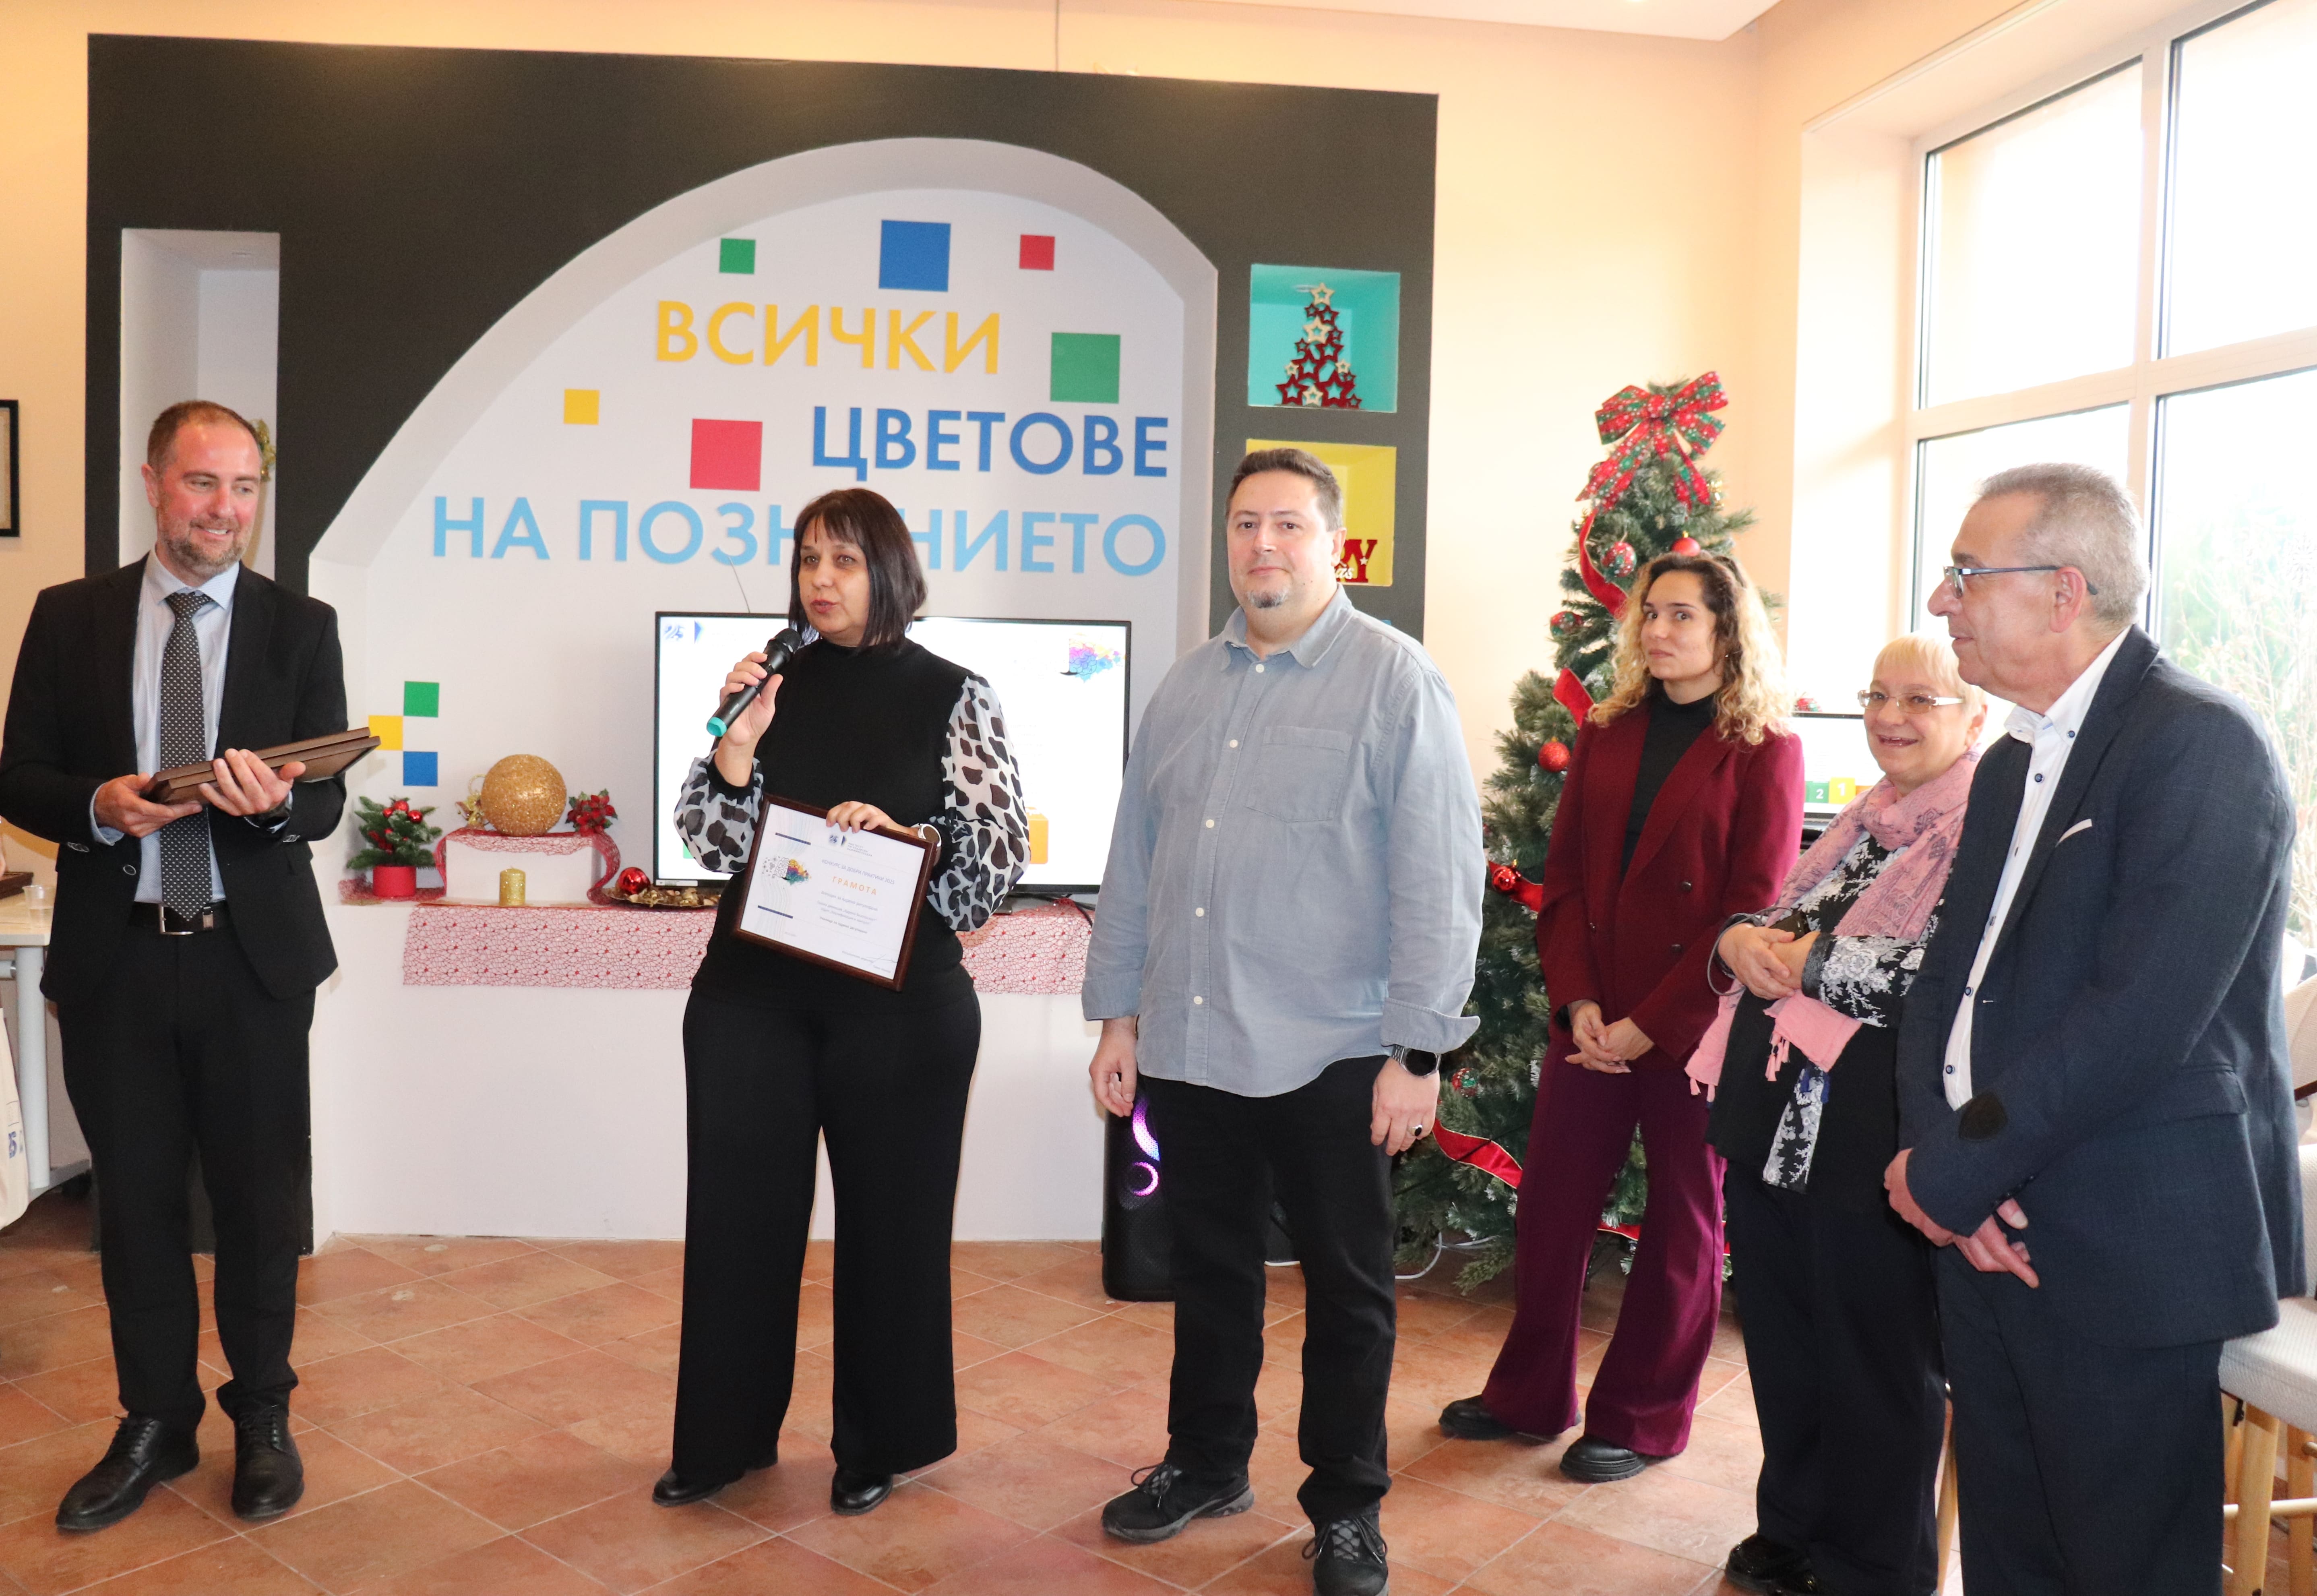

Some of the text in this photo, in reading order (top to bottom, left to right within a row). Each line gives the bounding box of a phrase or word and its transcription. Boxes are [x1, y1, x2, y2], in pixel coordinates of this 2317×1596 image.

[656, 300, 1000, 374] ВСИЧКИ
[813, 406, 1168, 481] ЦВЕТОВЕ
[433, 496, 1166, 577] НА ПОЗННИЕТО
[1816, 783, 1845, 799] 2 1
[822, 859, 840, 868] КОНКУРС
[847, 866, 862, 874] ДОБРИ
[862, 871, 884, 881] ПРАКТИКИ
[832, 876, 876, 895] ГРАМОТА
